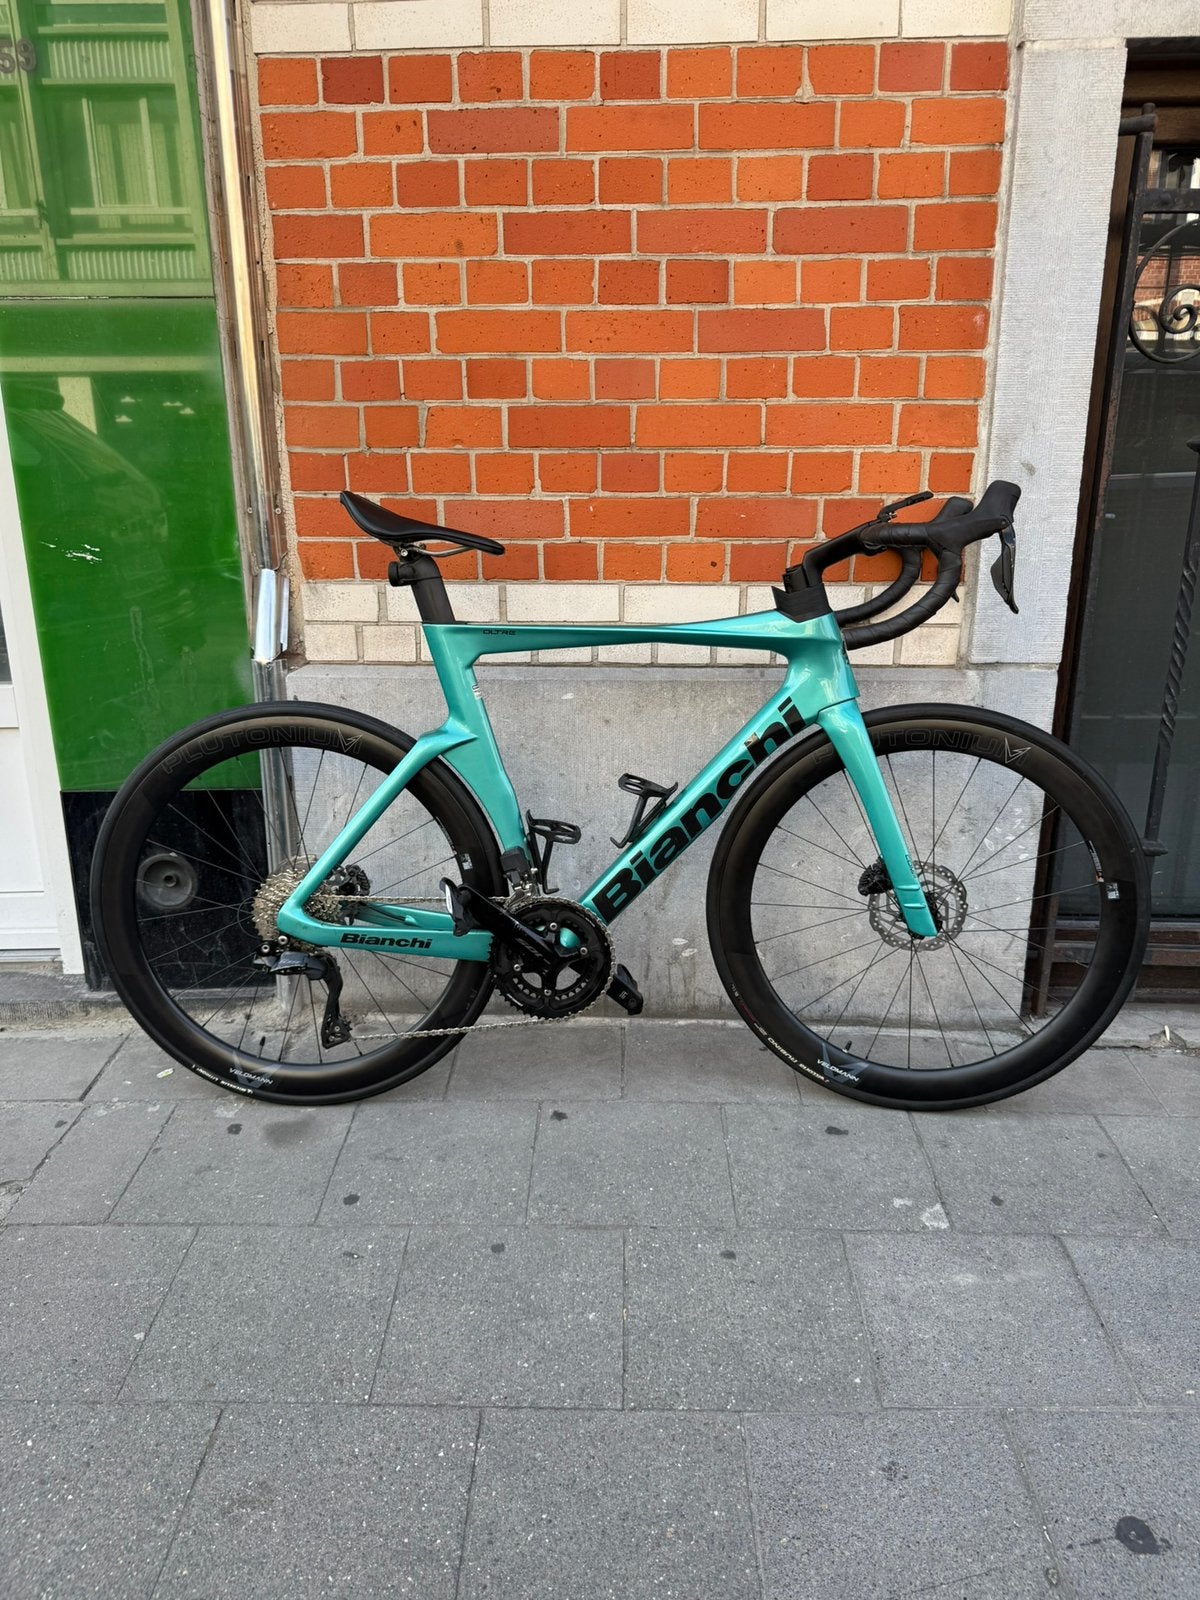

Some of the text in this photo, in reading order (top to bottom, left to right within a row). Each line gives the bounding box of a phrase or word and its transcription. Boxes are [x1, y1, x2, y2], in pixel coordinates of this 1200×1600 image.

[161, 726, 363, 776] PLUTONIUM
[591, 695, 806, 926] Bianchi
[341, 932, 433, 949] Bianchi
[229, 1067, 274, 1085] VELOMANN
[817, 1058, 860, 1082] VELOMANN
